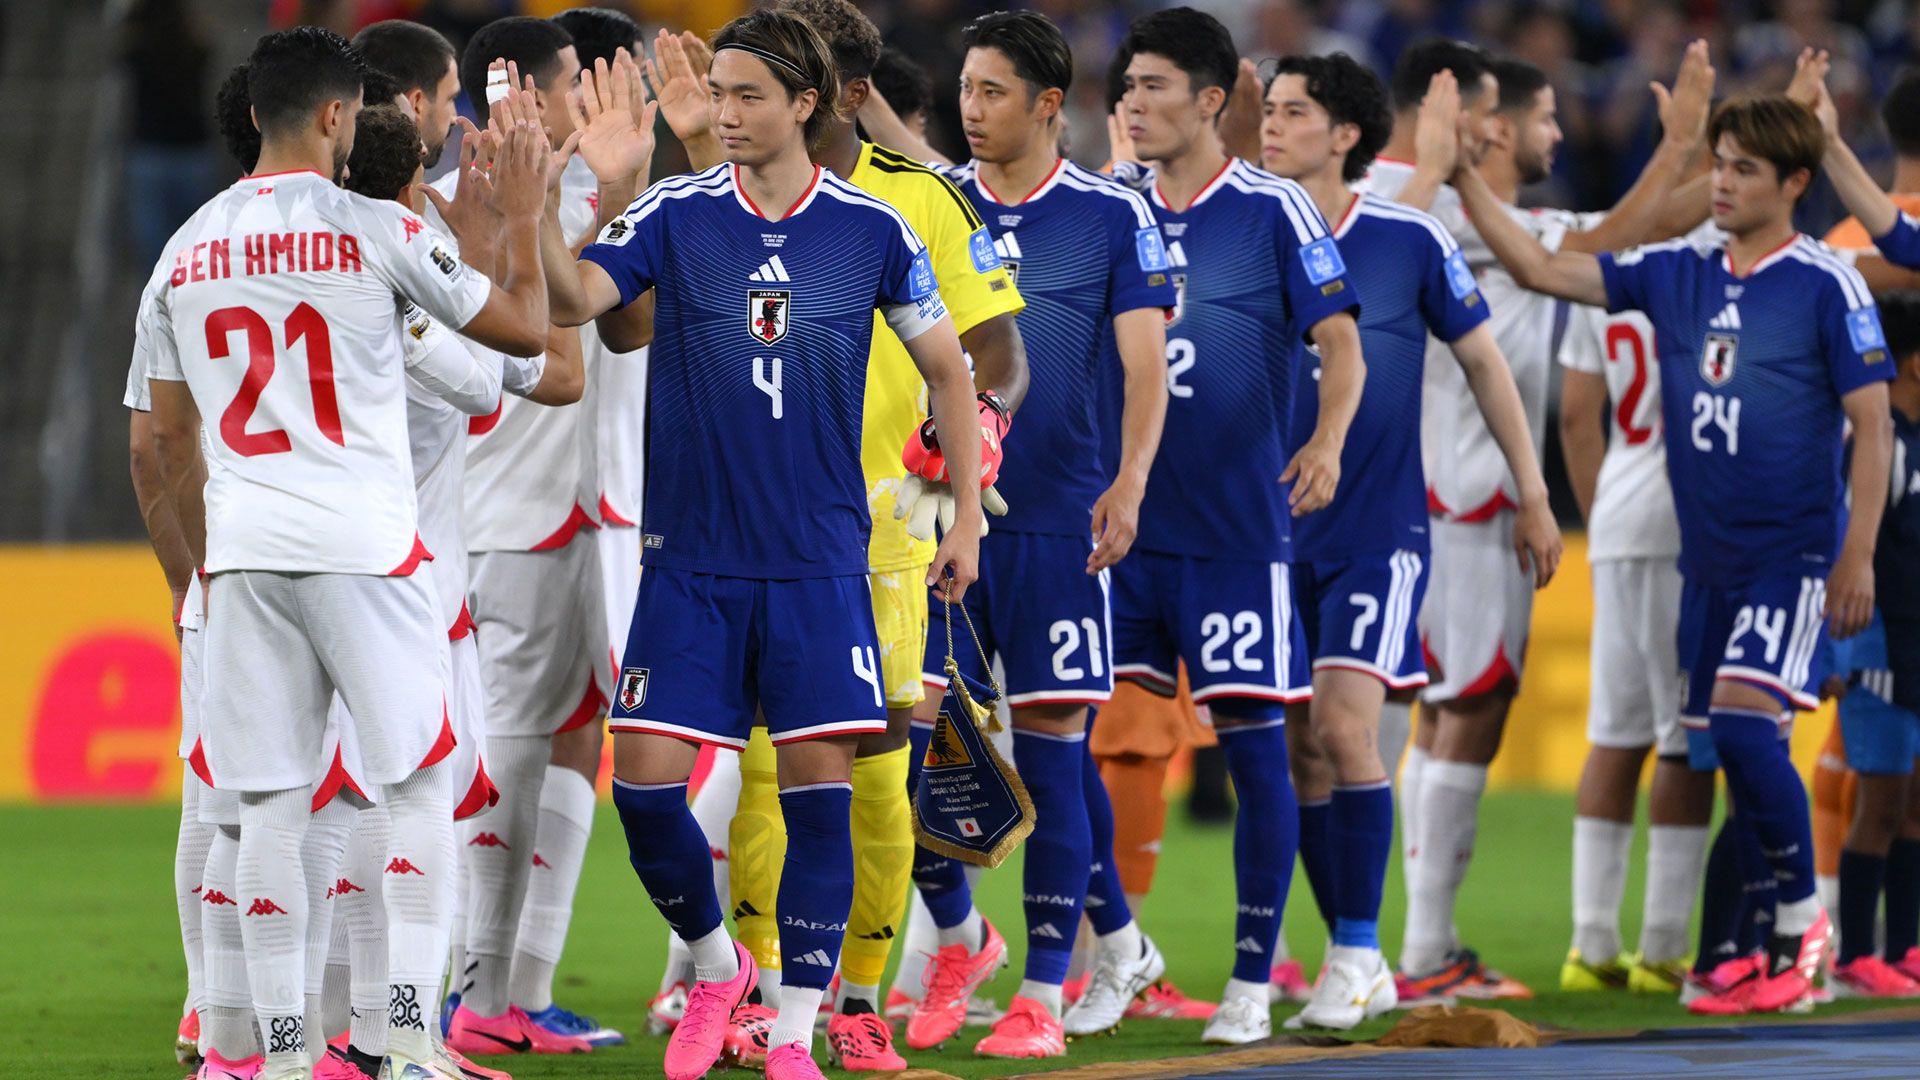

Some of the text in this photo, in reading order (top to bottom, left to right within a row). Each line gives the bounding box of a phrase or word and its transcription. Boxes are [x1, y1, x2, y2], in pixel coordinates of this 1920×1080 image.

[170, 231, 362, 288] BEN HMIDA
[204, 301, 345, 457] 21
[752, 357, 783, 419] 4
[1691, 391, 1742, 456] 24
[1049, 617, 1104, 681] 21
[1201, 610, 1264, 673] 22
[1349, 592, 1379, 651] 7
[1724, 604, 1787, 664] 24
[851, 645, 883, 708] 4
